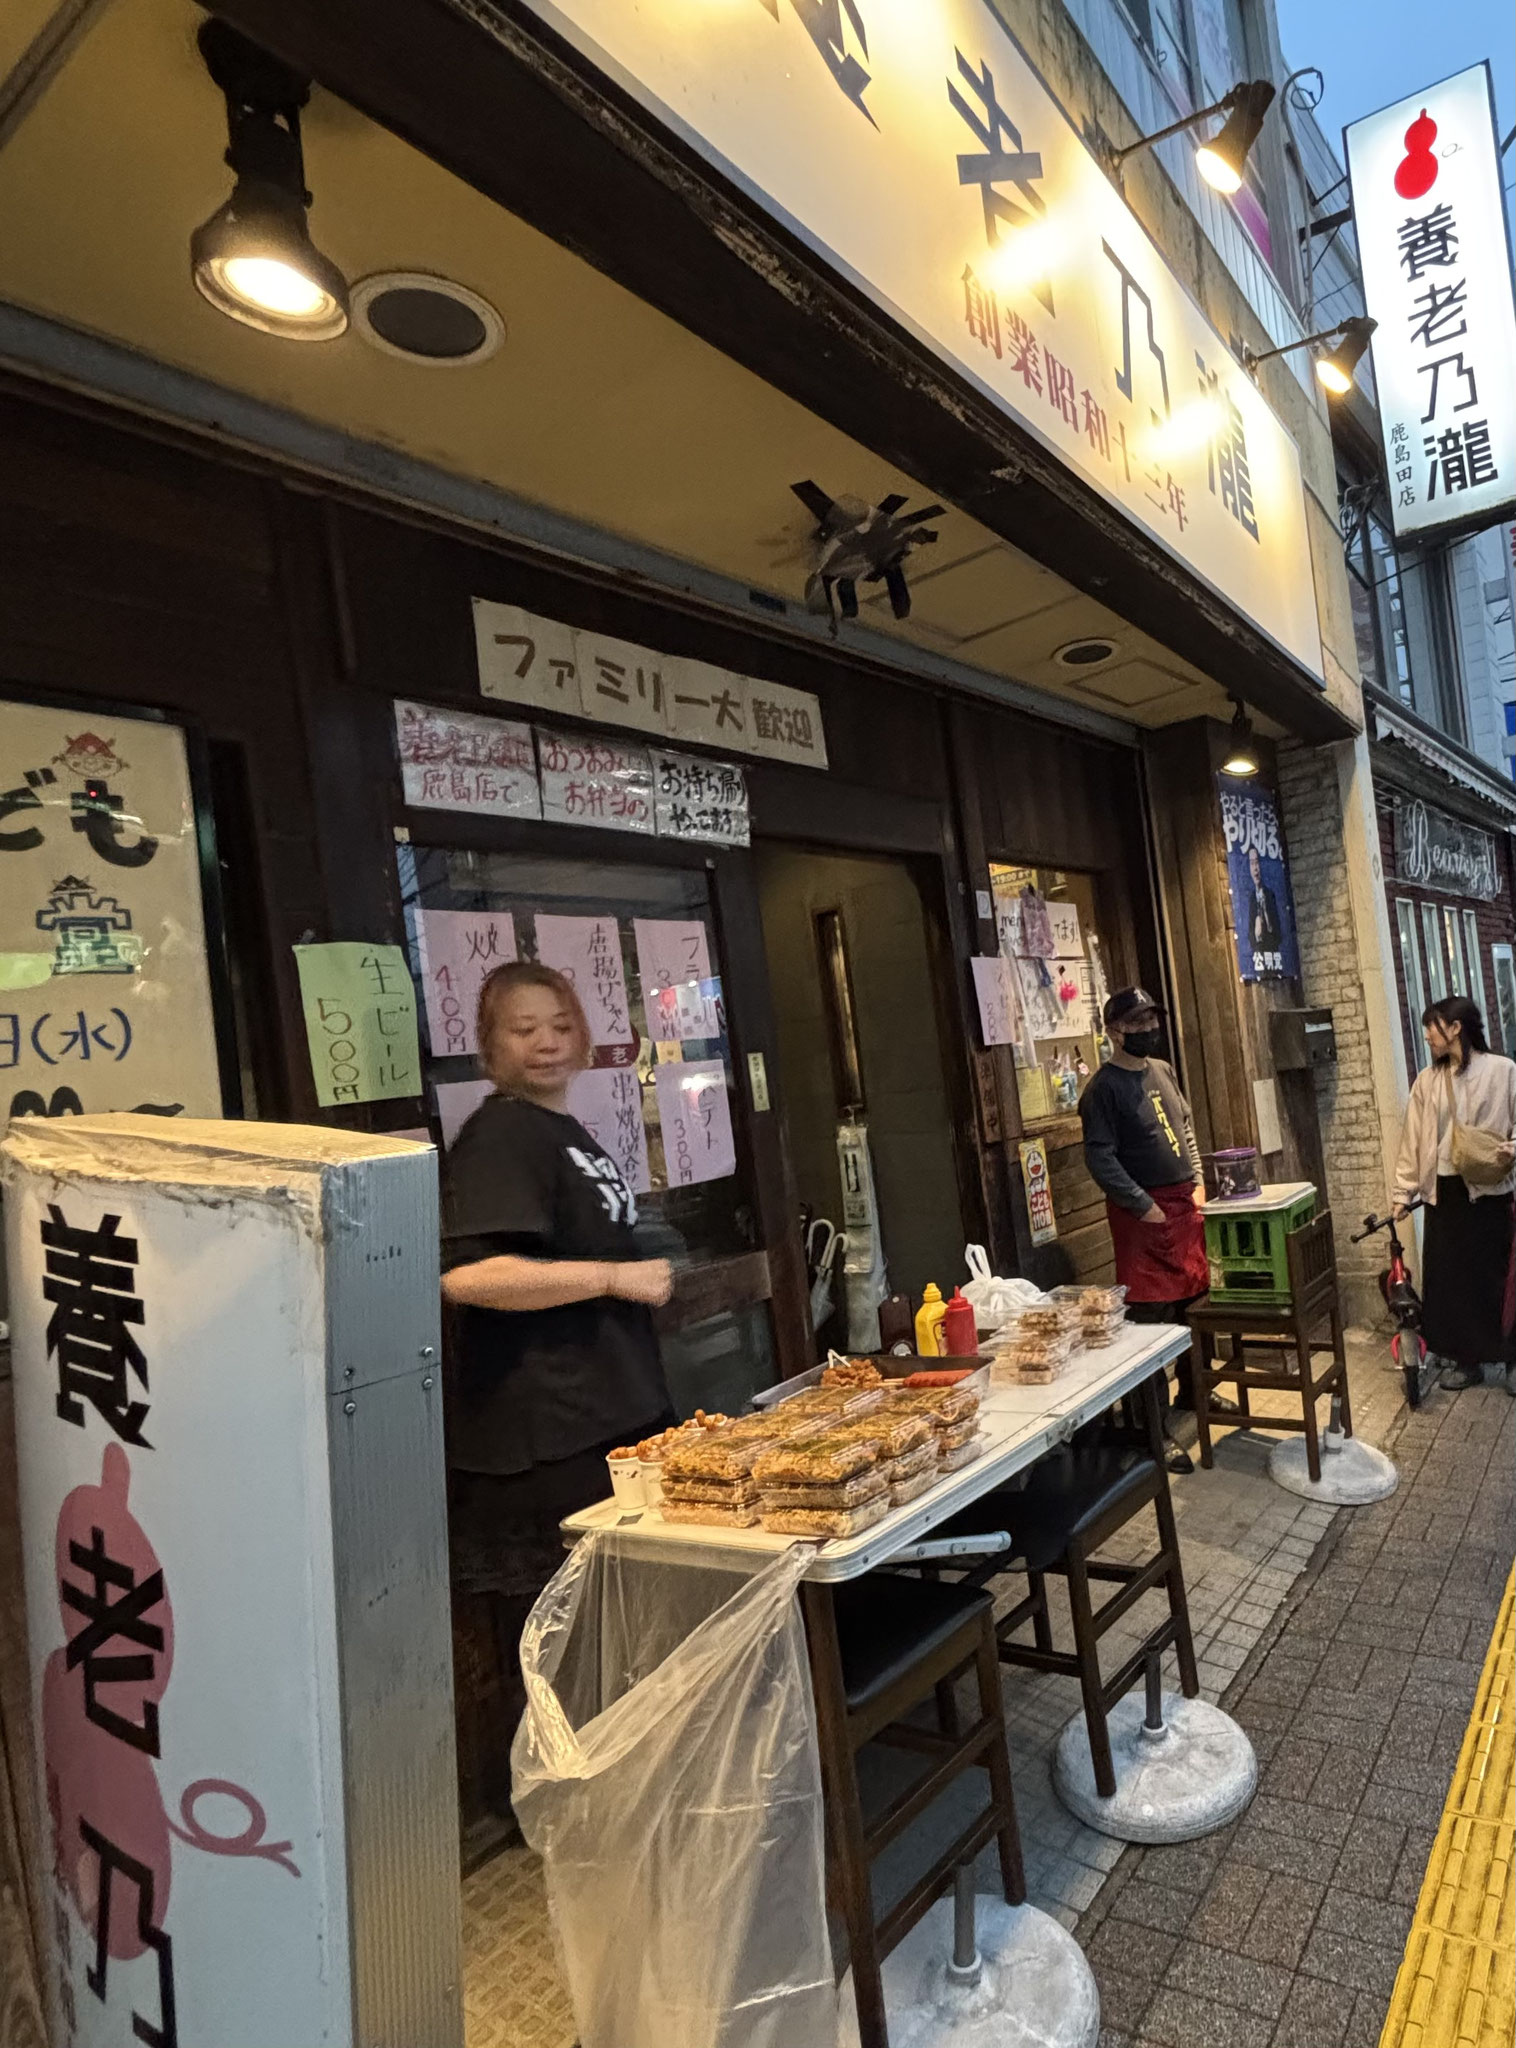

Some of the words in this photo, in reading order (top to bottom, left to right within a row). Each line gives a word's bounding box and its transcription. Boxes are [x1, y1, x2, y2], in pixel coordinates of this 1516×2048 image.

[1397, 202, 1499, 501] 養老乃瀧
[1390, 422, 1416, 509] 鹿島田店
[493, 633, 814, 750] ファミリー大歓迎
[564, 781, 649, 822] お弁当の
[1222, 815, 1284, 861] やり切る。
[1252, 951, 1283, 971] 公明党
[317, 998, 360, 1101] 500円
[360, 957, 410, 1087] 生ビール
[435, 965, 467, 1053] 400円
[673, 1119, 694, 1182] 300円
